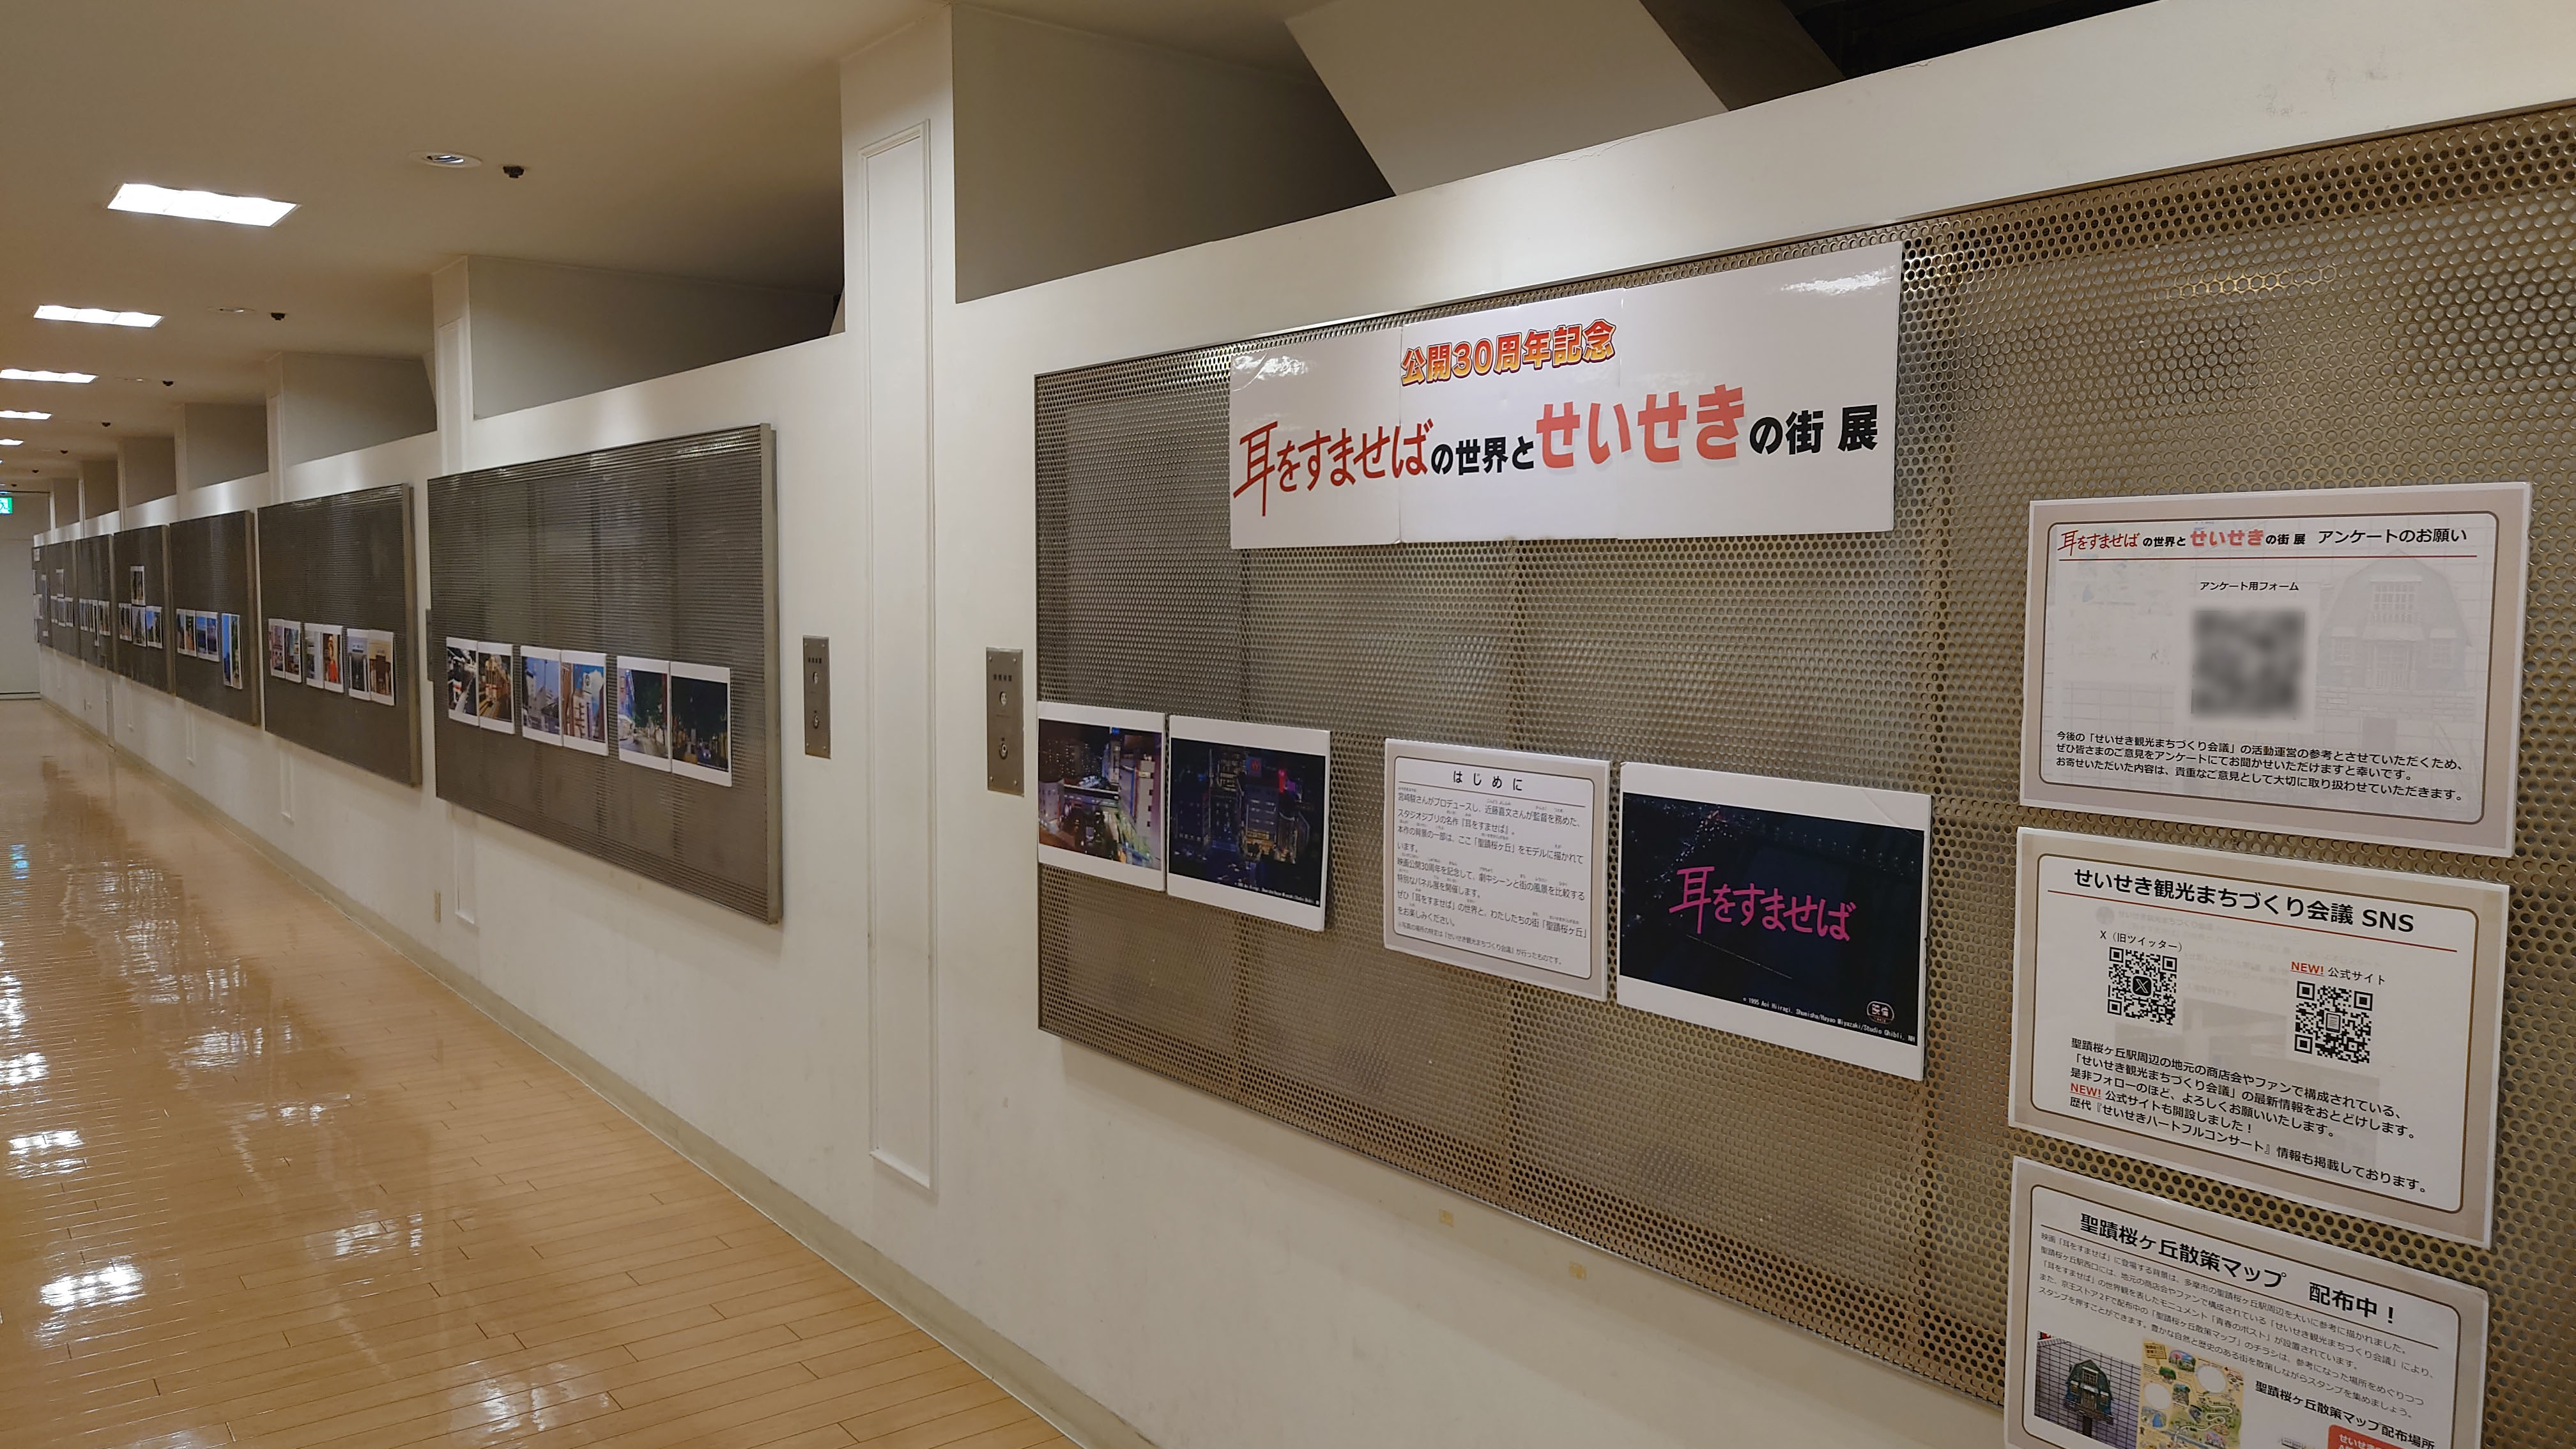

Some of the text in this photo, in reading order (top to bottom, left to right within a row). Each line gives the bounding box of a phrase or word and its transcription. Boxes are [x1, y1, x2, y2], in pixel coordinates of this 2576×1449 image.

[1401, 319, 1616, 387] 公開30周年記念
[1837, 404, 1878, 452] 展
[2293, 533, 2306, 546] 展
[2318, 528, 2467, 545] アンケートのお願い
[2200, 581, 2299, 592] アンケート用フォーム
[2056, 743, 2412, 781] ぜひ皆さまのご意見をアンケートにてお聞かせいただけますと幸いです。
[2057, 731, 2464, 771] 今後の「せいせき観光まちづくり会議」の活動運営の参考とさせていただくため、
[2056, 756, 2462, 801] お寄せいただいた内容は、貴重なご意見として大切に取り扱わせていただきます。
[1397, 843, 1418, 853] います。
[1669, 866, 1857, 941] 耳をすませば
[2074, 868, 2354, 926] せいせき観光まちづくり会議
[2361, 908, 2414, 933] SNS
[2290, 961, 2324, 976] NEW!
[2327, 966, 2386, 986] 公式サイト
[2070, 1068, 2335, 1137] 是非フォローのほど、よろしくお願いいたします。
[2071, 1037, 2401, 1119] 聖蹟桜ヶ丘駅周辺の地元の商店会やファンで構成されている、
[2076, 1053, 2415, 1139] 「せいせき観光まちづくり会議」の最新情報をおとどけします。
[2070, 1083, 2252, 1133] NEW! 公式サイトも開設しました！
[2070, 1097, 2427, 1194] 歴代『せいせきハートフルコンサート』情報も掲載しております。
[2080, 1213, 2394, 1324] 聖蹟桜ヶ丘散策マップ 配布中！
